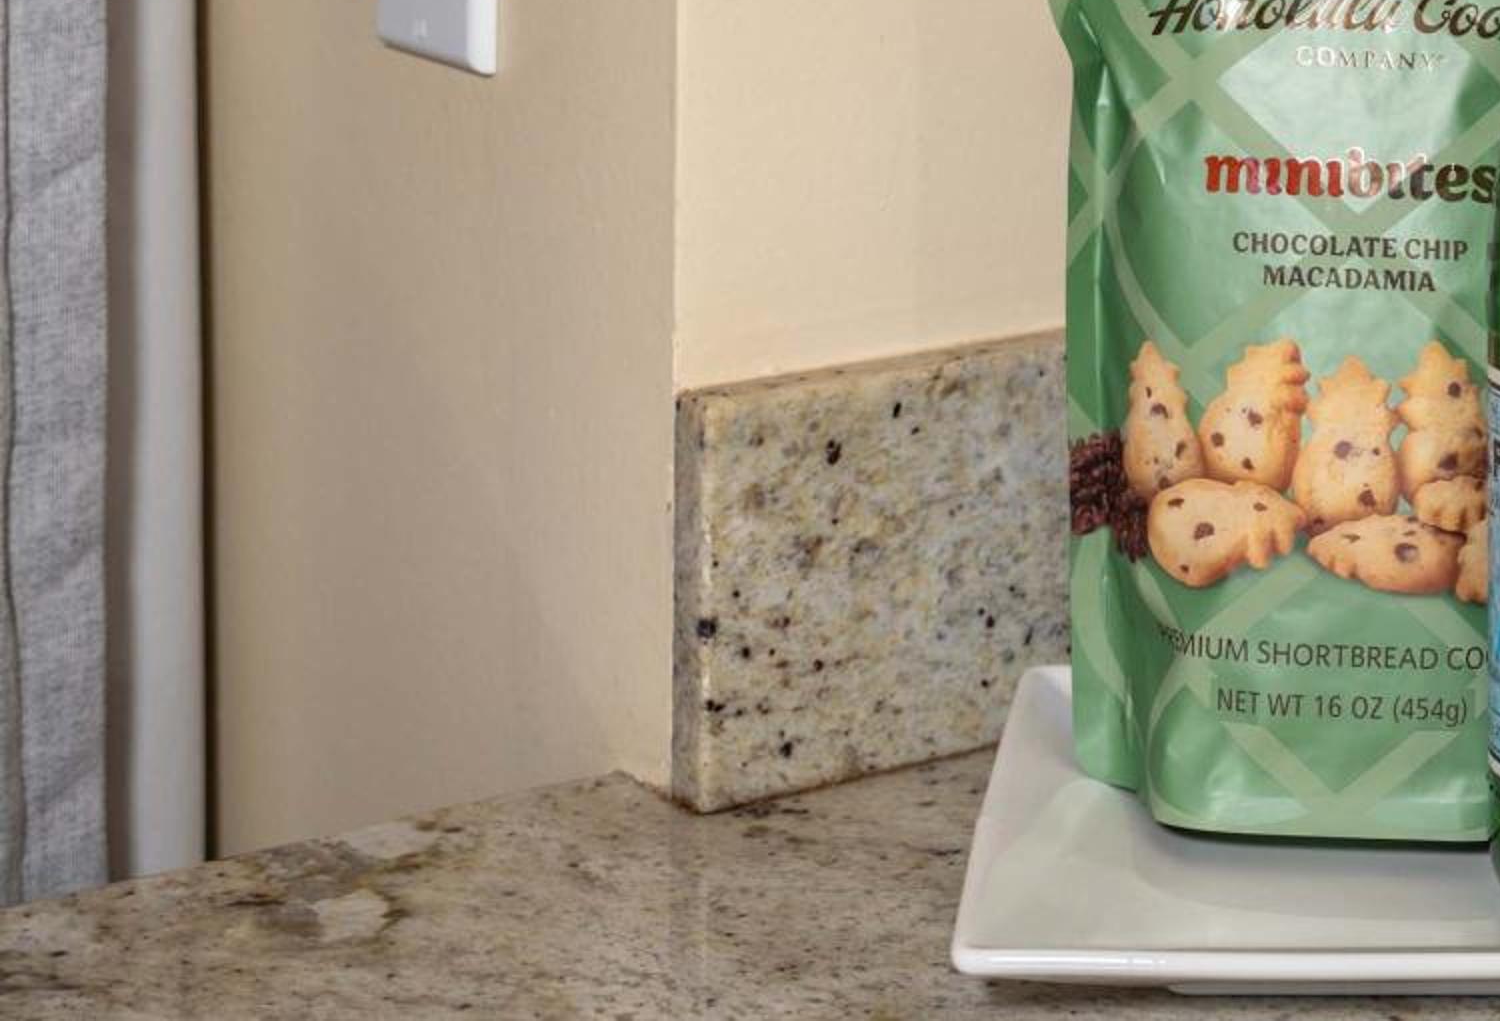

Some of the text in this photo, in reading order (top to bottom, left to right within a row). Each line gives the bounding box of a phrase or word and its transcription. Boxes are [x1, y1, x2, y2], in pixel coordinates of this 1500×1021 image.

[1203, 146, 1498, 204] minibites
[1232, 232, 1469, 262] CHOCOLATE CHIP
[1262, 264, 1437, 293] MACADAMIA
[1256, 640, 1439, 670] SHORTBREAD
[1216, 687, 1469, 729] NET WT 16 OZ (454g)
